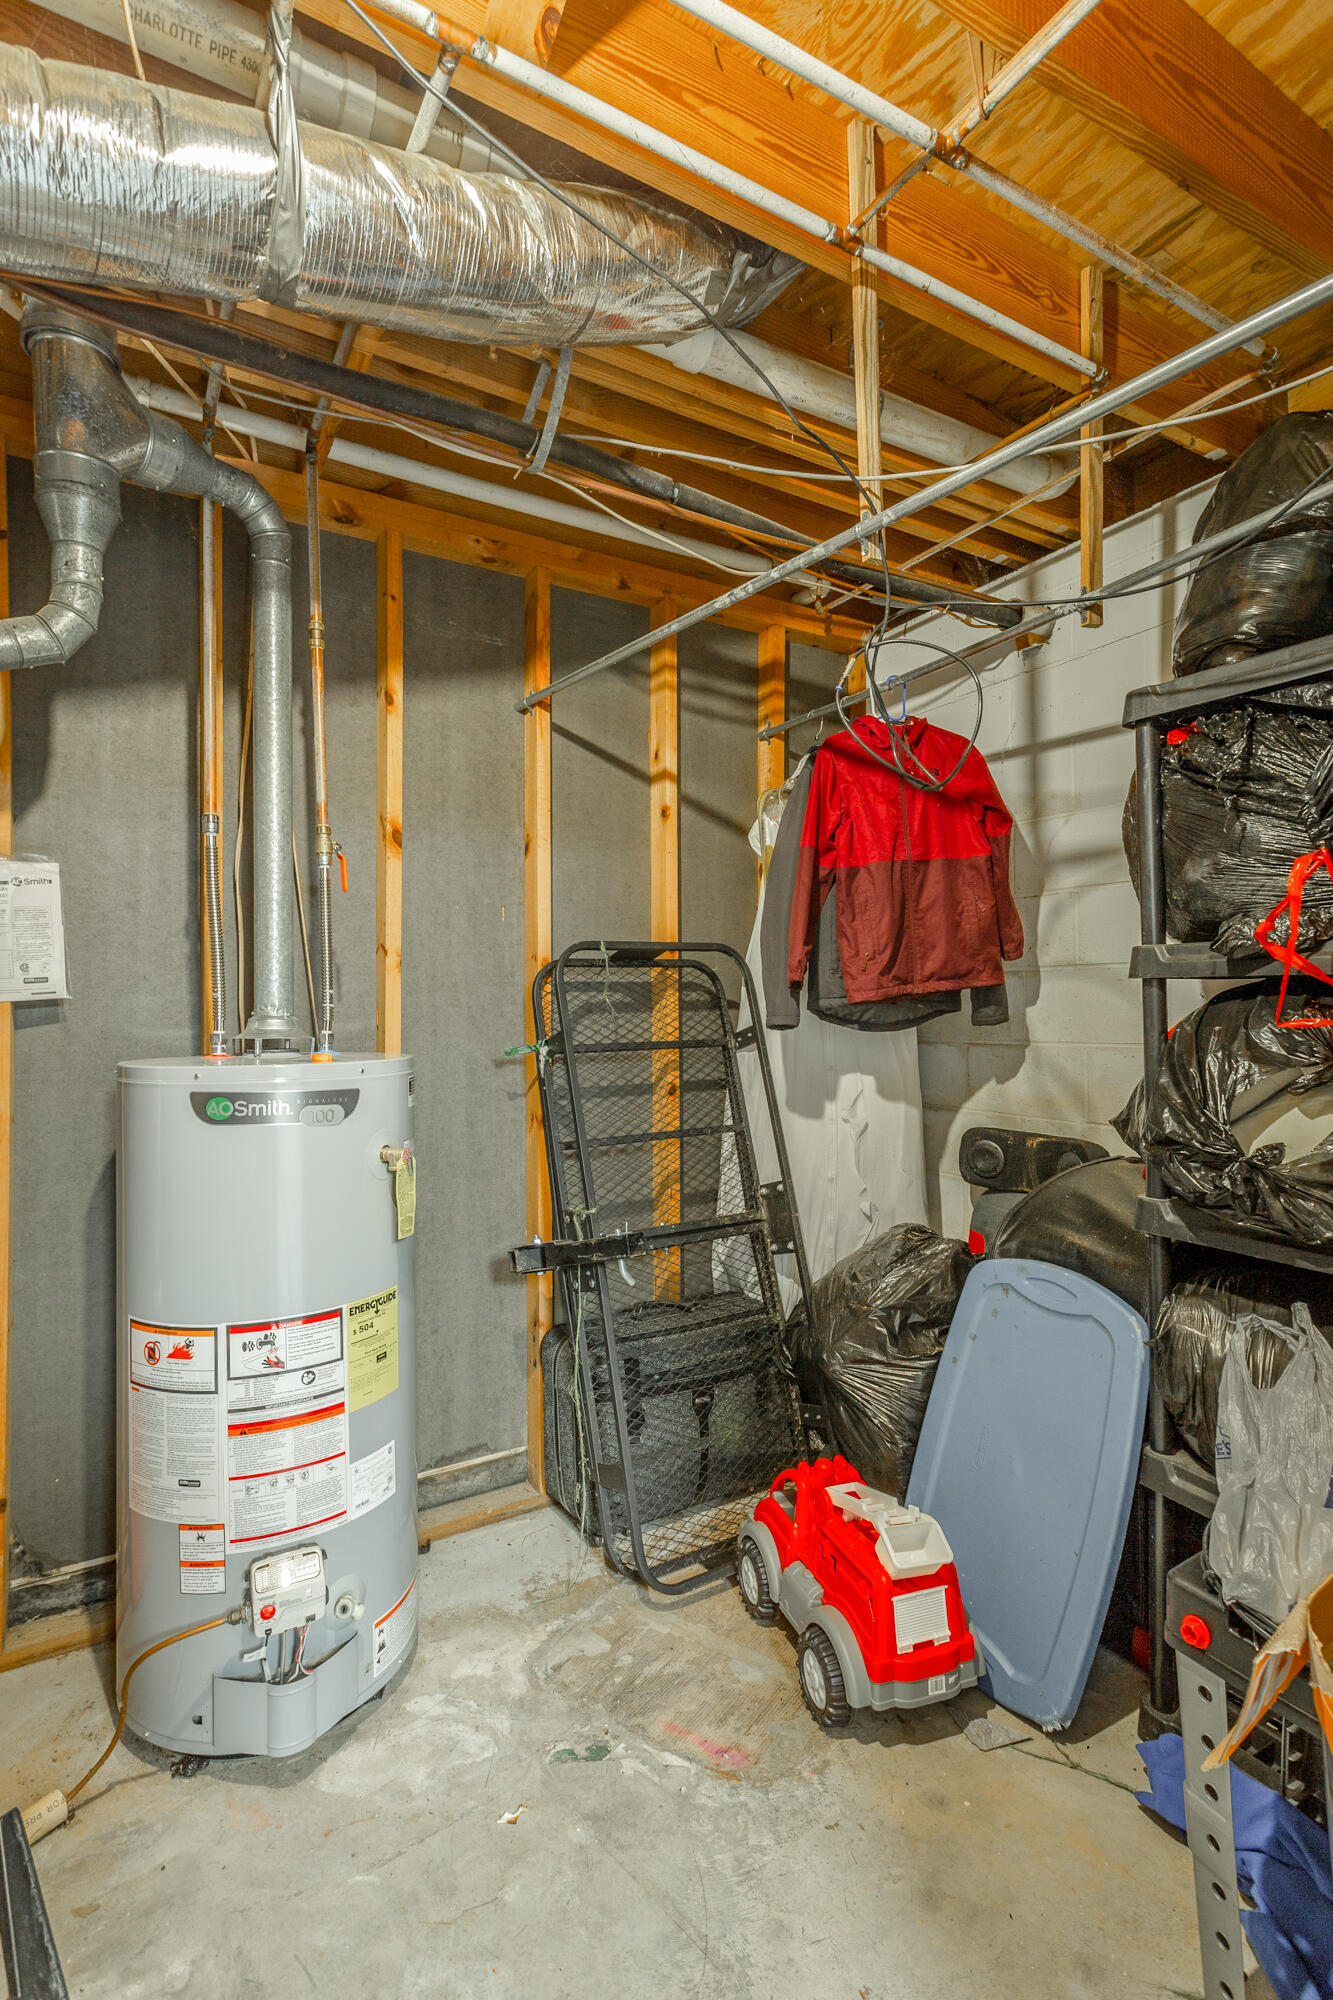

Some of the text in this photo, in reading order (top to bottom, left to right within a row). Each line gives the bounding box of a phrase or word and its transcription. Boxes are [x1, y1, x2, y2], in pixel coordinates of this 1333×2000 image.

[209, 39, 237, 65] PIPE
[359, 1321, 374, 1334] 504
[47, 1796, 66, 1812] FOR
